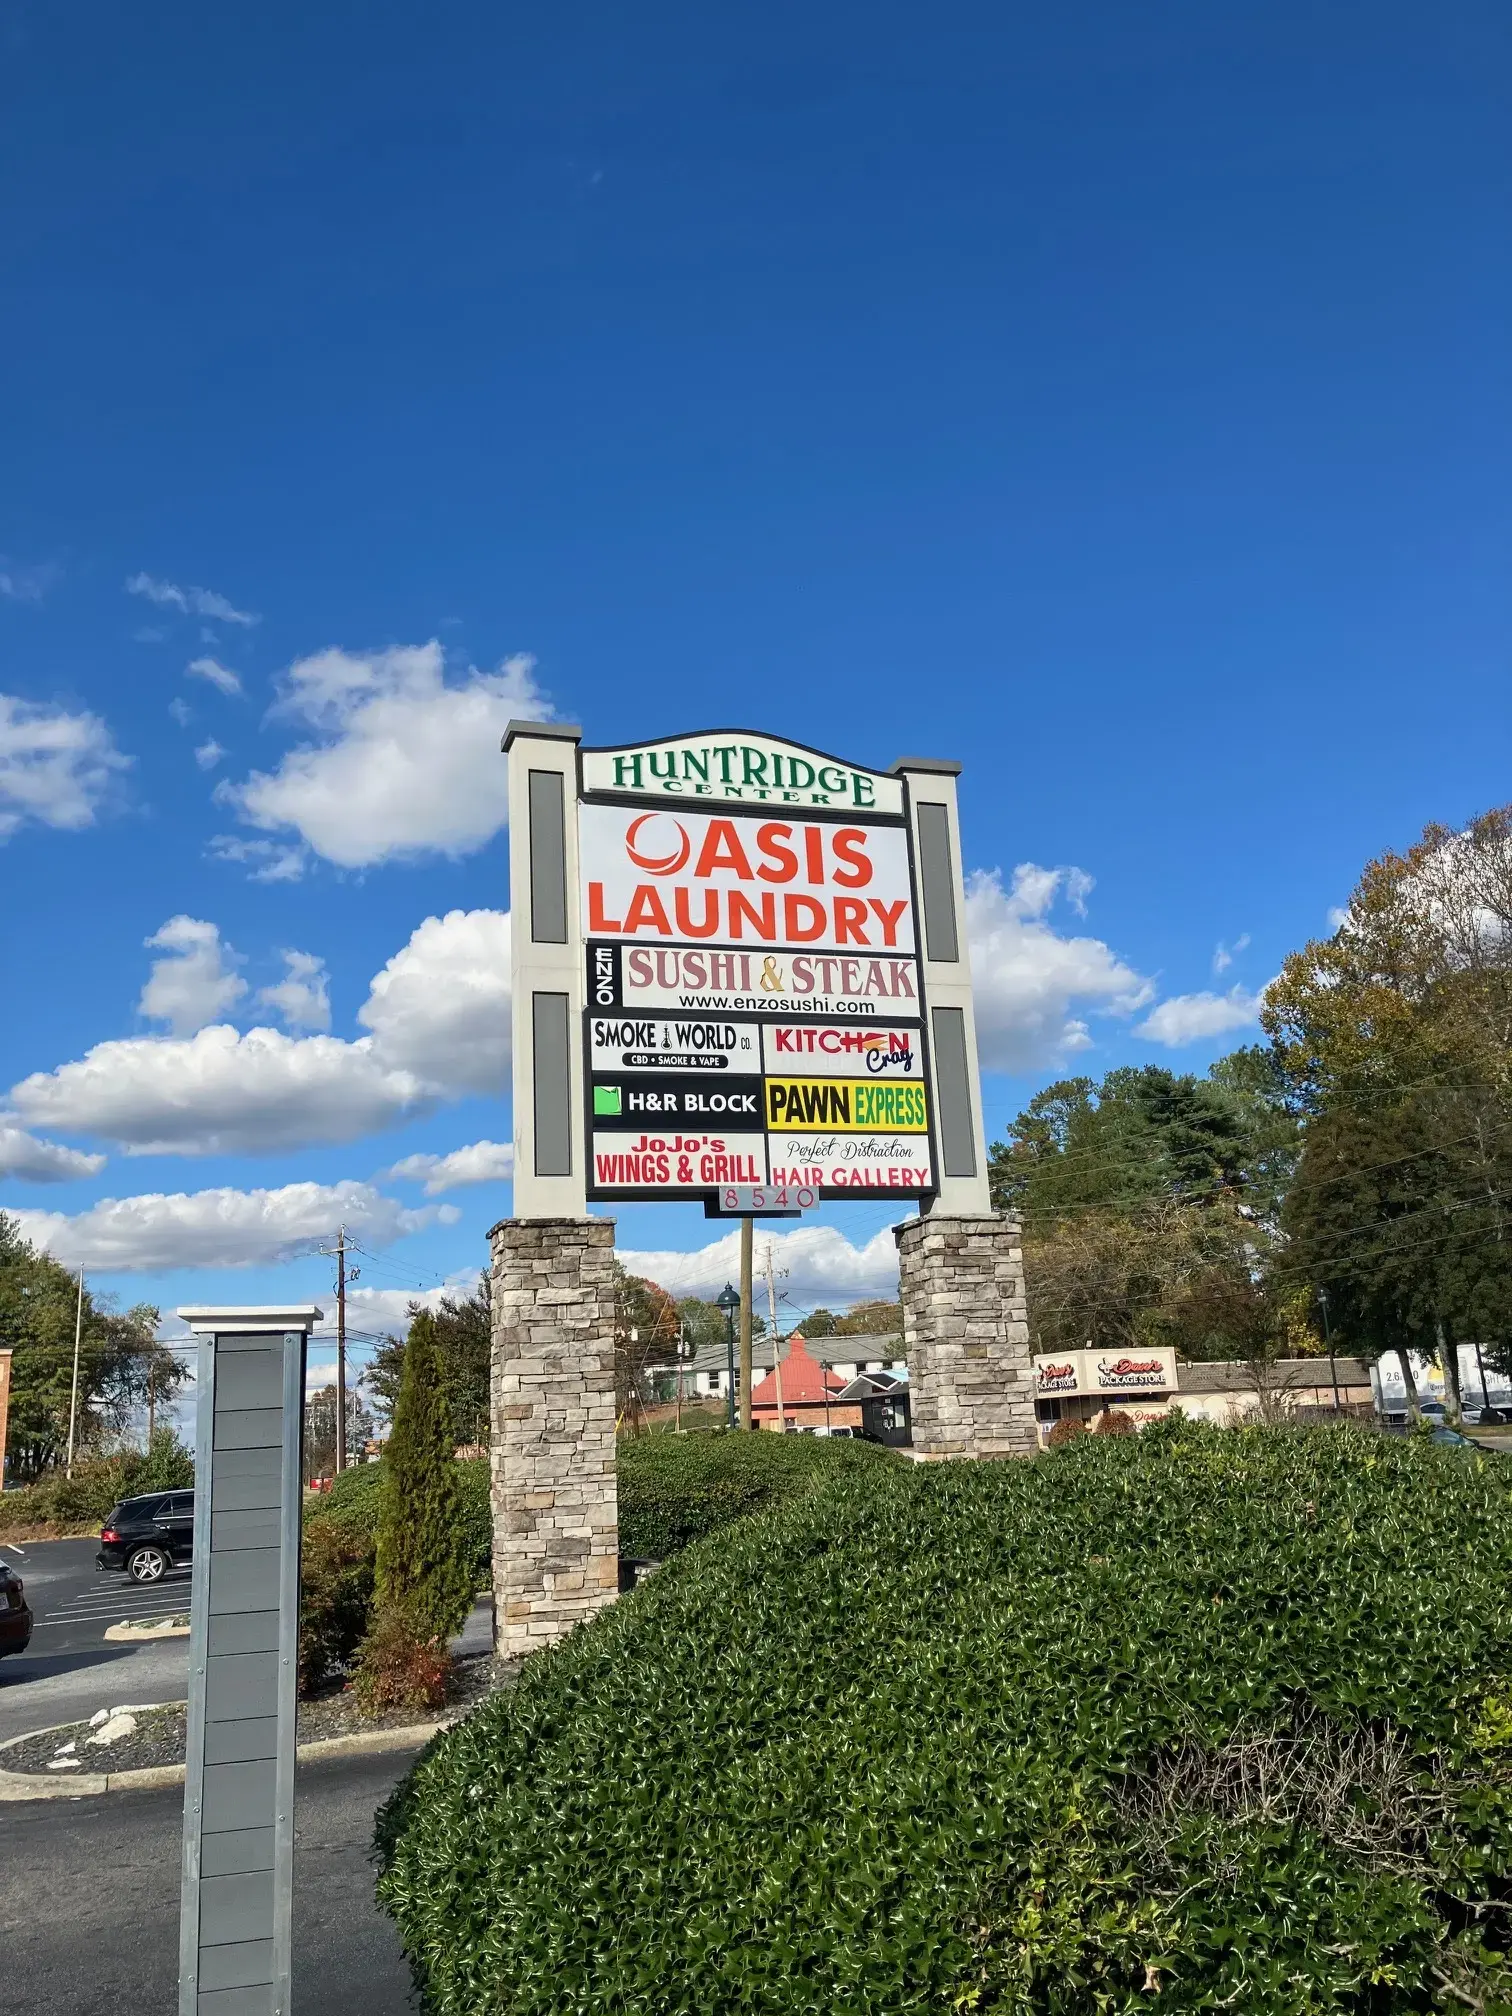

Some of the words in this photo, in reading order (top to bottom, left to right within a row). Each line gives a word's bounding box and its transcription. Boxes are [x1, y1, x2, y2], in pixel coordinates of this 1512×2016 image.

[612, 745, 876, 807] HUNTRIDGE
[662, 781, 831, 805] CENTER
[625, 813, 873, 888] OASIS
[588, 881, 909, 947] LAUNDRY
[595, 947, 614, 1006] ENZO
[628, 949, 753, 992] SUSHI
[760, 955, 785, 993] &
[792, 956, 916, 998] STEAK
[679, 995, 875, 1014] www.enzosushi.com
[595, 1020, 657, 1048] SMOKE
[675, 1023, 737, 1050] WORLD
[740, 1037, 752, 1050] CO.
[775, 1028, 910, 1054] KITCHEN
[631, 1054, 649, 1065] CBD
[658, 1055, 688, 1066] SMOKE
[690, 1056, 697, 1066] &
[699, 1056, 720, 1067] VAPE
[628, 1092, 679, 1112] H&R
[684, 1093, 758, 1113] BLOCK
[769, 1084, 851, 1124] PAWN
[855, 1086, 925, 1126] EXPRESS
[631, 1135, 726, 1153] JoJo's
[787, 1137, 840, 1164] Perfect
[840, 1138, 914, 1161] Distraction
[596, 1154, 670, 1183] WINGS
[677, 1154, 694, 1183] &
[700, 1154, 761, 1183] GRILL
[772, 1167, 824, 1187] HAIR
[831, 1167, 929, 1187] GALLERY
[1098, 1375, 1138, 1387] PACKAGE
[1138, 1374, 1167, 1386] STORE
